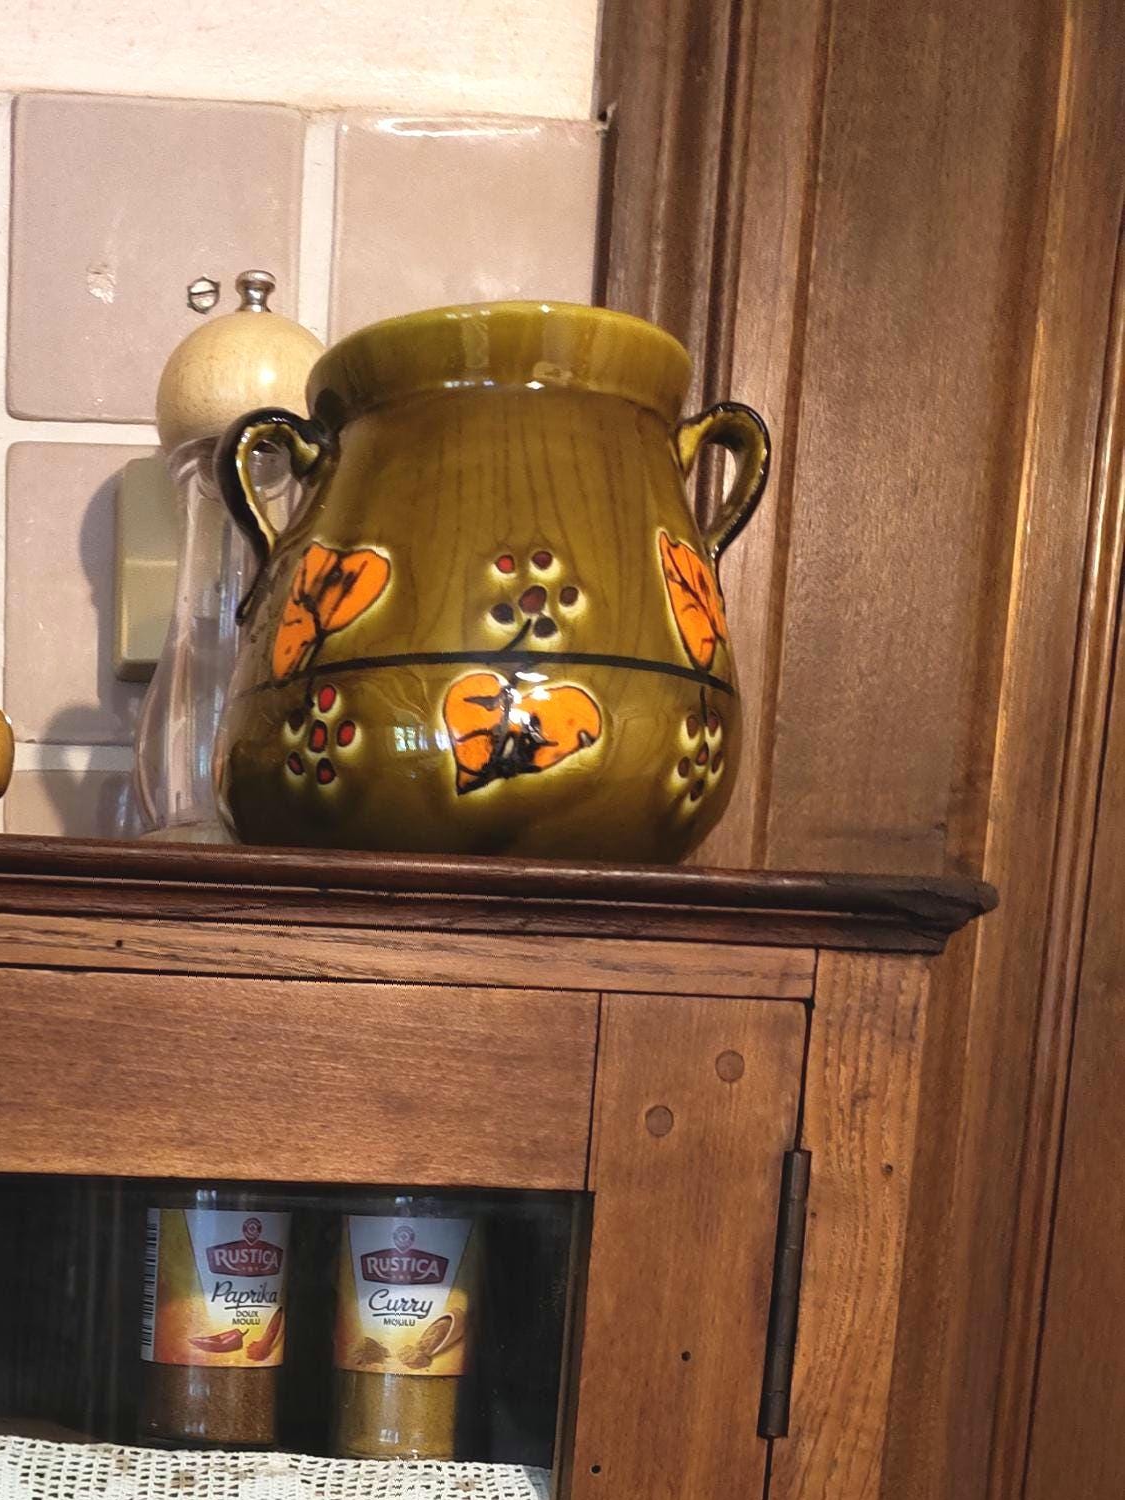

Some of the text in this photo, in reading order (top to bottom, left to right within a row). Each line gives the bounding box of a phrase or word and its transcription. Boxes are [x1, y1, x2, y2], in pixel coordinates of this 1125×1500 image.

[213, 1248, 279, 1272] RUSTICA
[366, 1256, 440, 1280] RUSTICA
[211, 1280, 277, 1307] Paprika
[369, 1288, 433, 1319] Curry
[232, 1317, 261, 1326] MOULU
[236, 1310, 259, 1318] DOUX
[383, 1318, 416, 1327] MOULU
